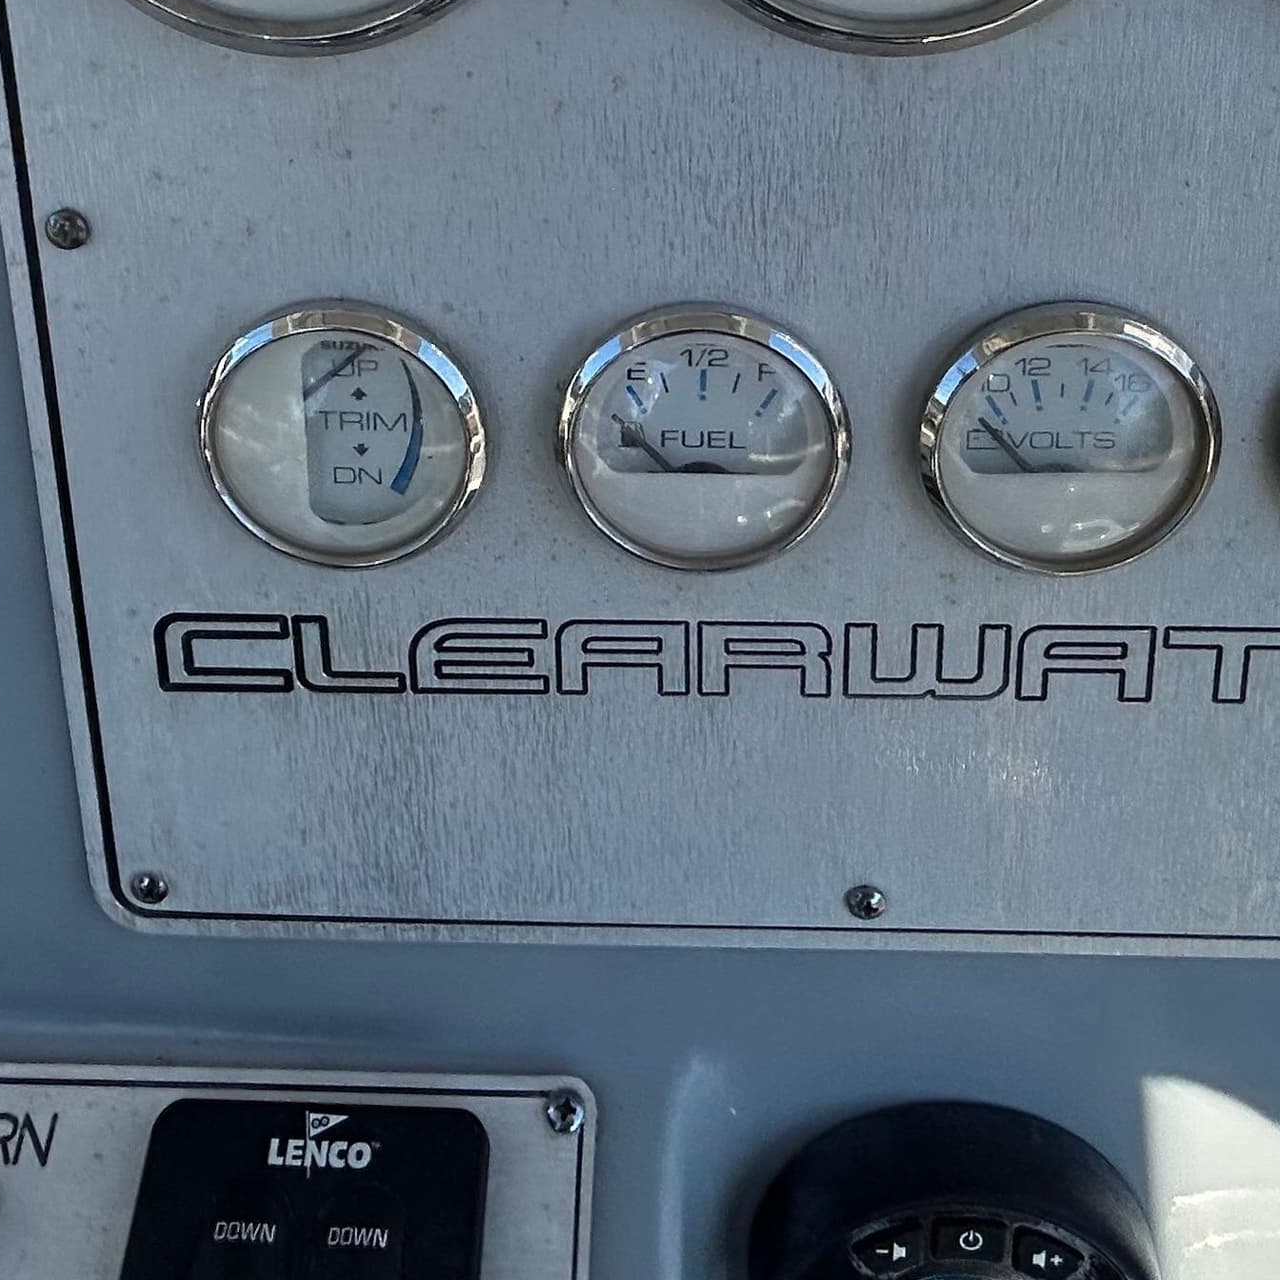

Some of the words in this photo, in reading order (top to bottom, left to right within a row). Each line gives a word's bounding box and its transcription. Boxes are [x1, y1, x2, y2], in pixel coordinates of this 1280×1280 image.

[680, 348, 730, 368] 1/2
[1014, 357, 1052, 377] 12
[1080, 357, 1114, 376] 14
[333, 360, 379, 377] UP
[627, 362, 647, 381] E
[315, 410, 408, 433] TRIM
[661, 429, 747, 449] FUEL
[1007, 431, 1117, 450] VOLTS
[334, 466, 383, 485] DN
[267, 1138, 372, 1169] LENCO
[214, 1222, 276, 1243] DOWN
[328, 1227, 388, 1249] DOWN
